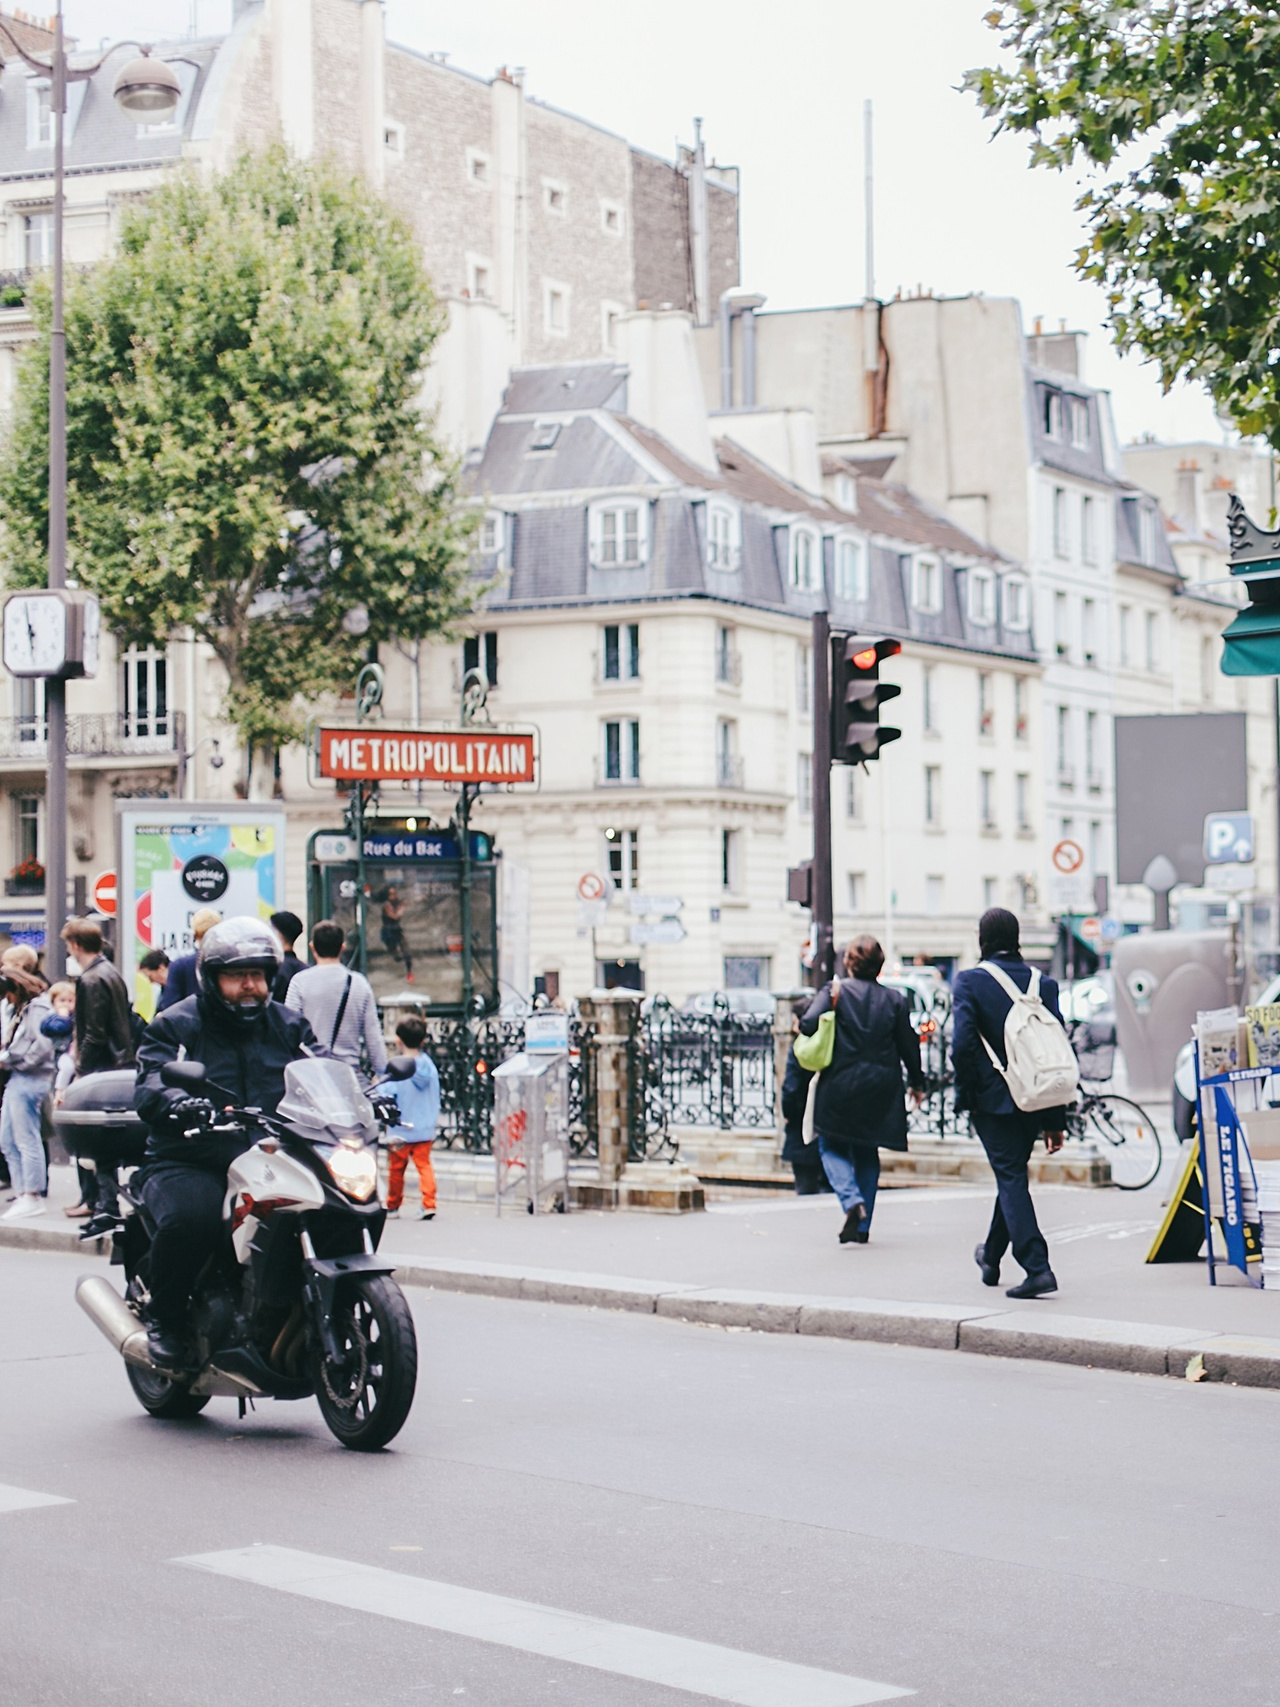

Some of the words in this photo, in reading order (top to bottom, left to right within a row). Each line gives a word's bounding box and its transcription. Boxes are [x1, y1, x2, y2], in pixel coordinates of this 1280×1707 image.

[330, 738, 527, 775] METROPOLITAIN
[363, 840, 391, 857] Rue
[394, 839, 414, 857] du
[416, 840, 442, 857] Bac
[1210, 821, 1235, 859] P
[1247, 1007, 1260, 1022] SO
[1228, 1072, 1241, 1081] LE
[1241, 1067, 1273, 1080] FIGARO
[1219, 1125, 1232, 1151] LE
[1221, 1154, 1238, 1226] FIGARO
